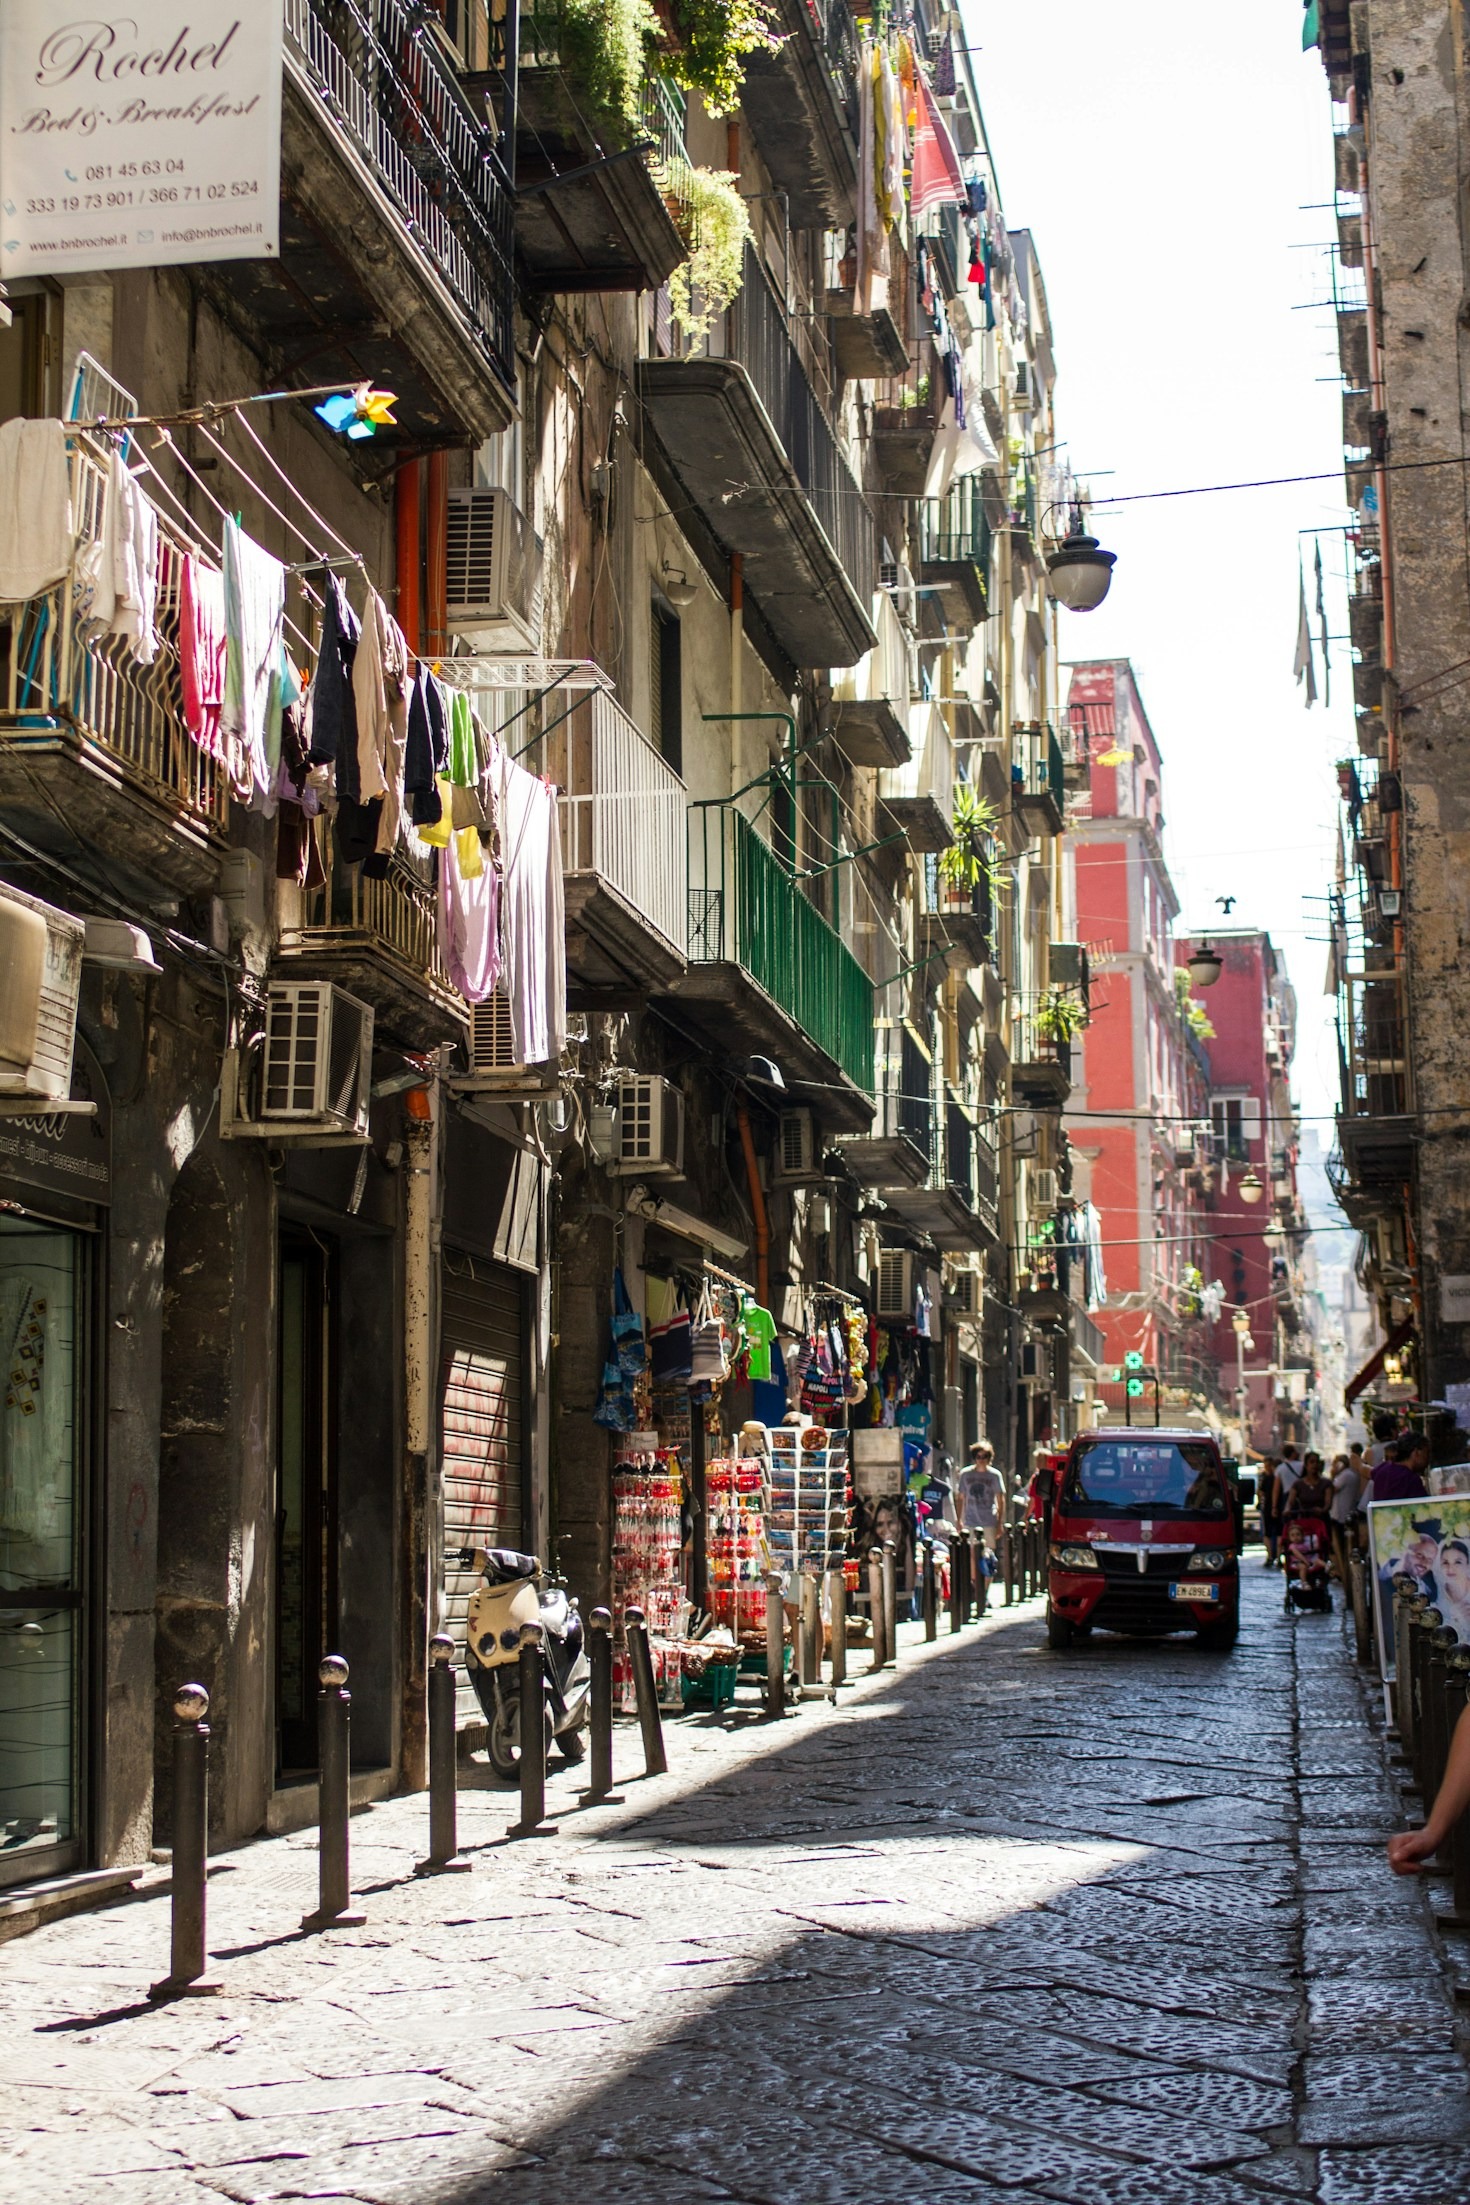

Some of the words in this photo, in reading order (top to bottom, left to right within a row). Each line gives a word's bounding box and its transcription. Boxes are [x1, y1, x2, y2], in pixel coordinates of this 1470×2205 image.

[35, 18, 241, 87] Rochel
[11, 106, 82, 134] Bed
[107, 91, 261, 125] Breakfast
[85, 165, 113, 181] 081
[118, 162, 138, 177] 45
[142, 160, 161, 175] 63
[166, 158, 185, 174] 04
[26, 197, 55, 214] 333
[62, 195, 80, 211] 19
[84, 193, 102, 209] 73
[106, 190, 134, 206] 901
[149, 187, 178, 203] 366
[184, 186, 201, 201] 71
[207, 184, 226, 199] 02
[230, 180, 259, 197] 524
[29, 233, 128, 252] www.bnbrochel.it
[161, 222, 264, 243] info@bnbrochel.it
[25, 1139, 49, 1166] bijoux
[53, 1152, 88, 1176] accessori
[88, 1162, 109, 1182] moda
[808, 1383, 828, 1393] NAPOLI
